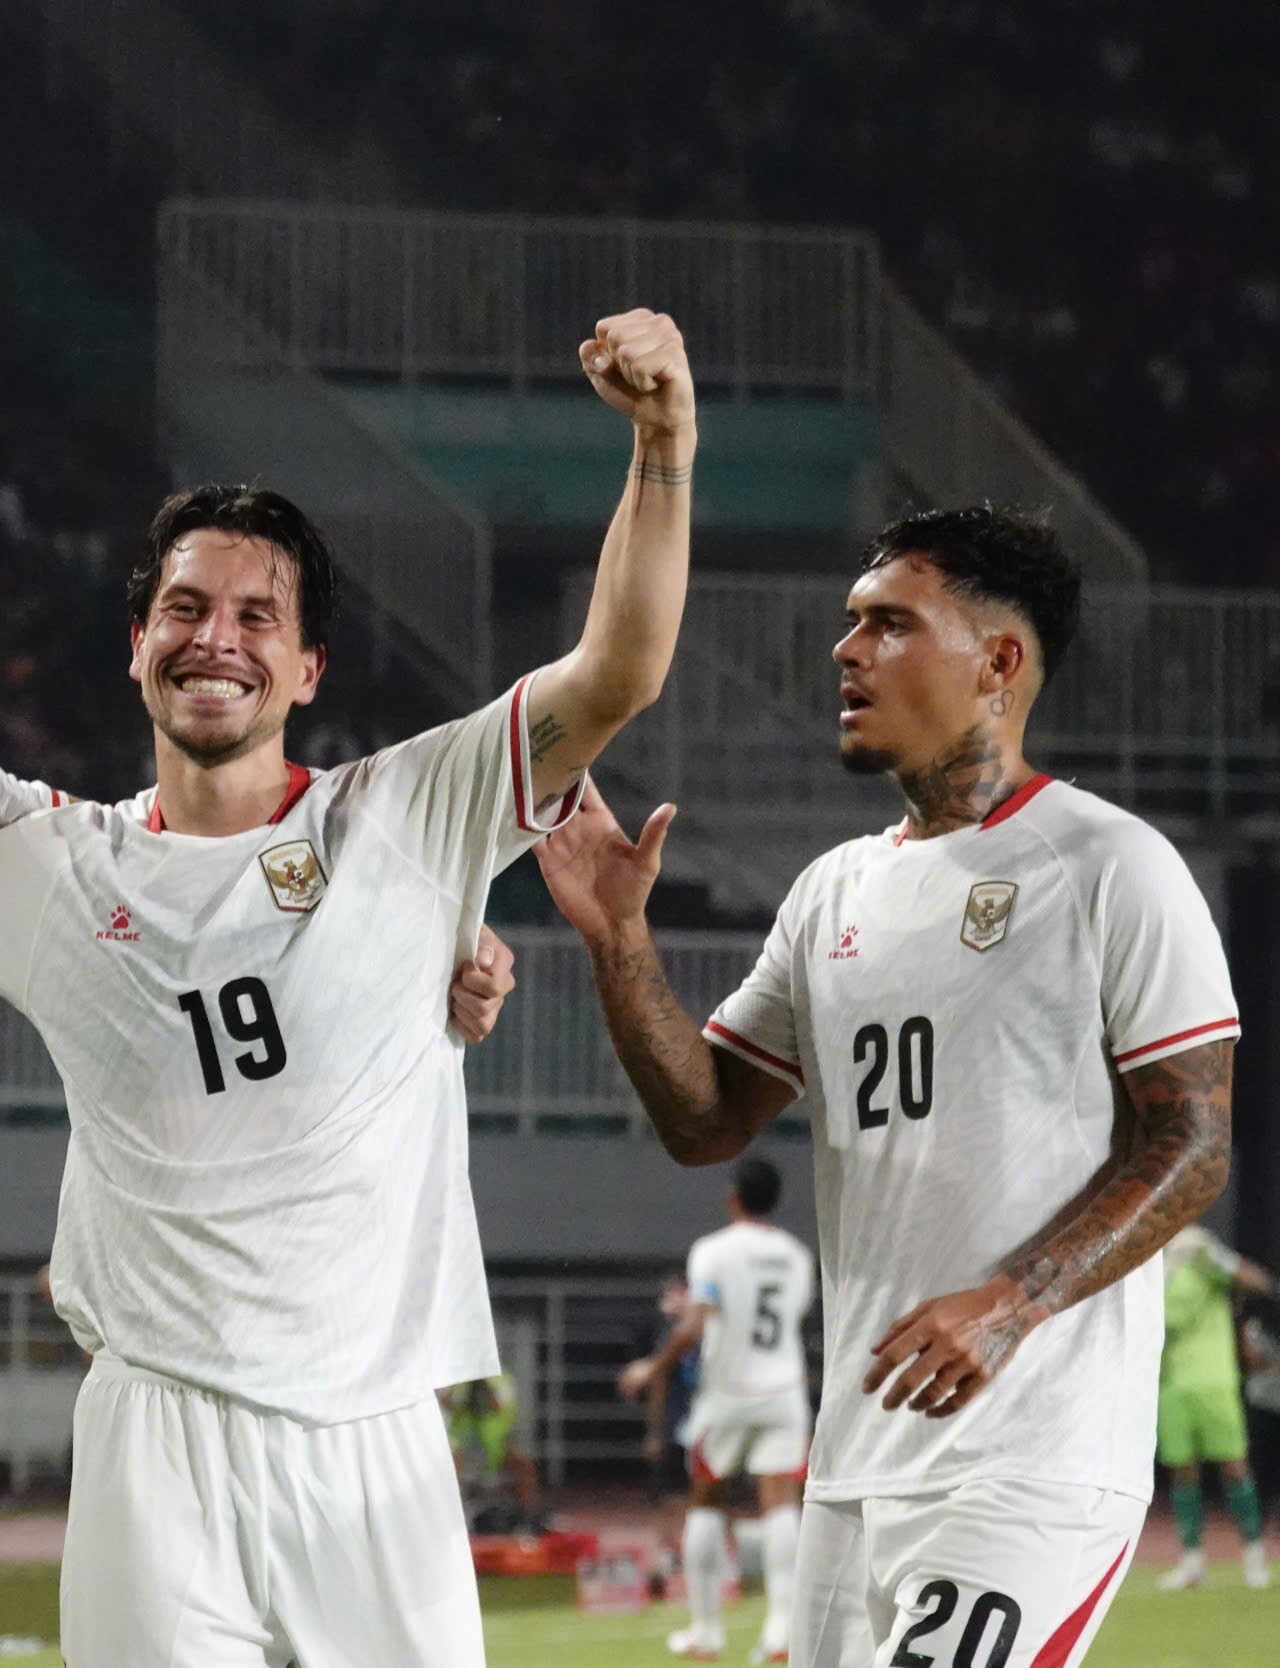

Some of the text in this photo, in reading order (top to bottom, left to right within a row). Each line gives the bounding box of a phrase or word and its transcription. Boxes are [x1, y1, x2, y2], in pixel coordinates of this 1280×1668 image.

[96, 931, 142, 942] KELME
[177, 976, 287, 1096] 19
[853, 1015, 934, 1131] 20
[752, 1283, 782, 1353] 5
[888, 1579, 1022, 1668] 20
